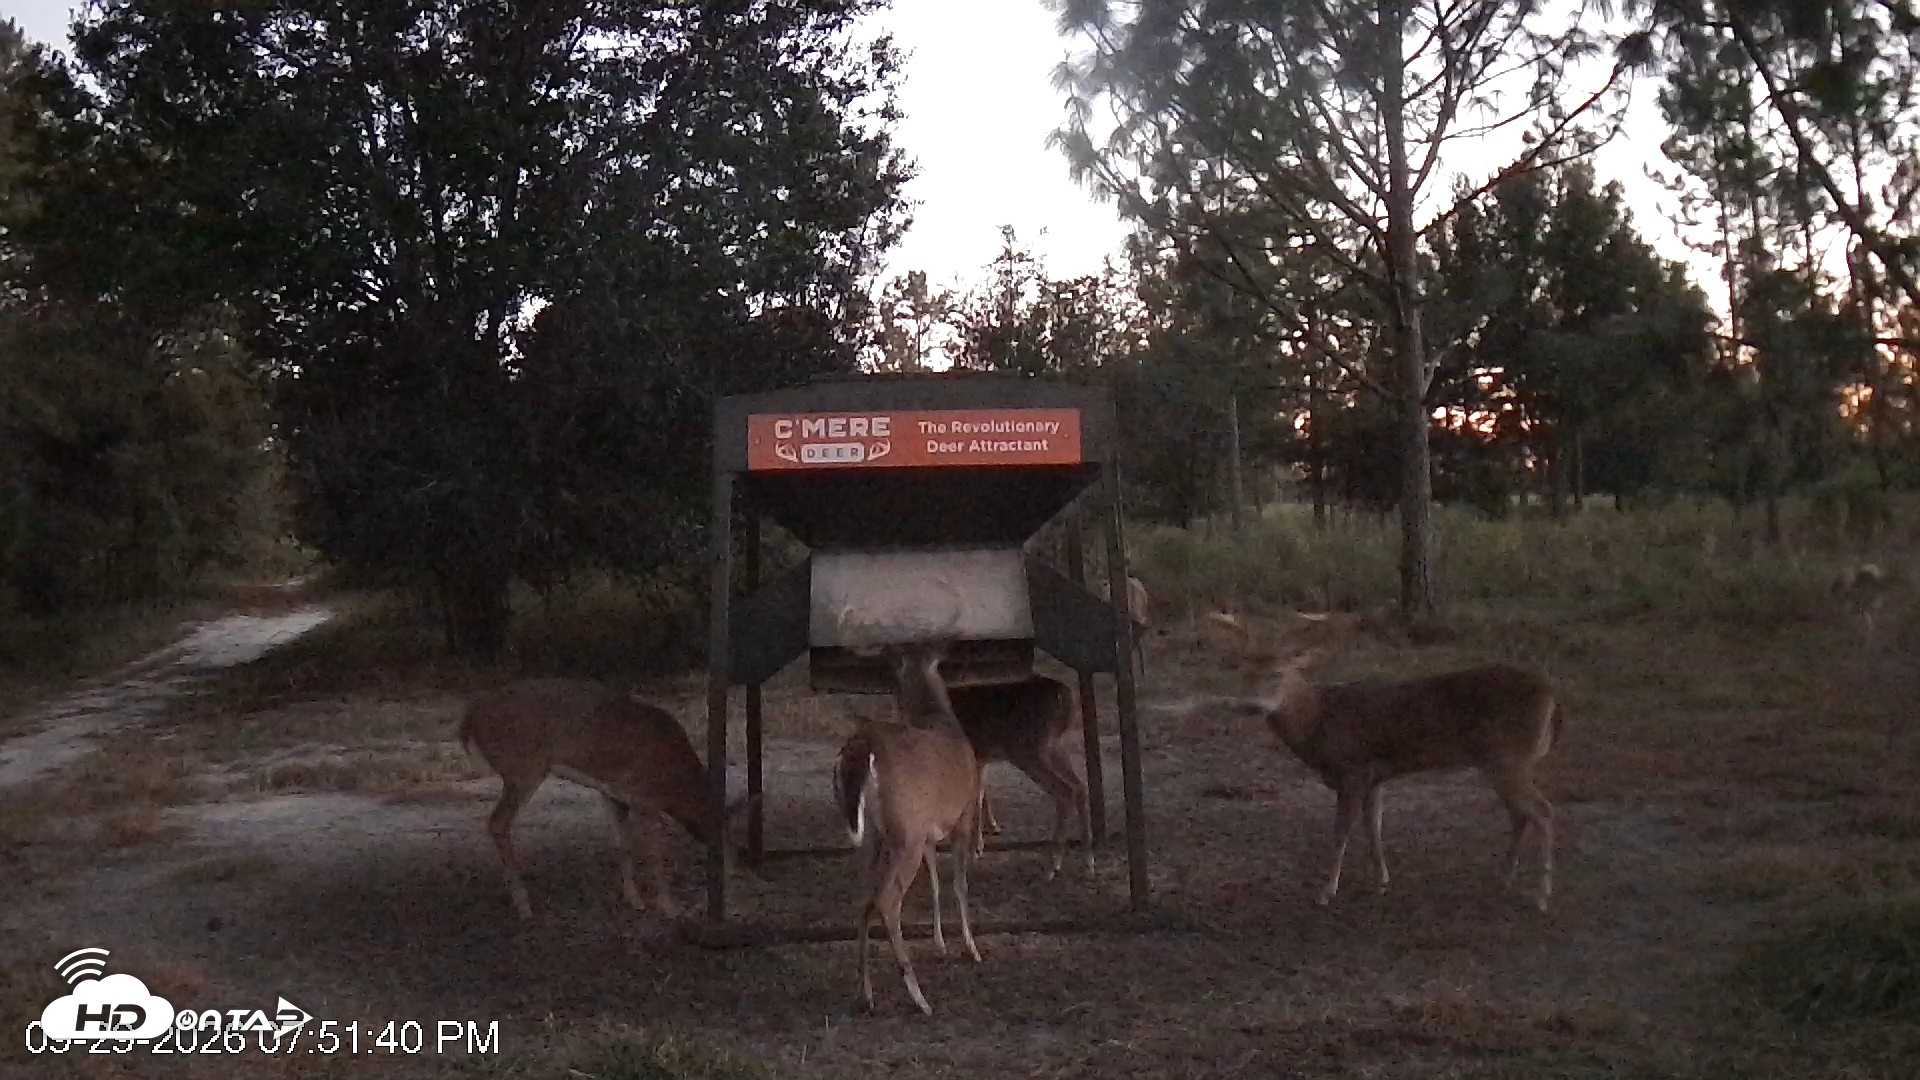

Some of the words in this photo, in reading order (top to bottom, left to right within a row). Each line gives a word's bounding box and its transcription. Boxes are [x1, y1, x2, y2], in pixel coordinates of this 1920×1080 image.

[775, 416, 891, 439] C'MERE
[918, 420, 948, 434] The
[951, 419, 1060, 435] Revolutionary
[807, 447, 859, 459] DEER
[926, 439, 965, 453] Deer
[968, 438, 1049, 453] Attractant
